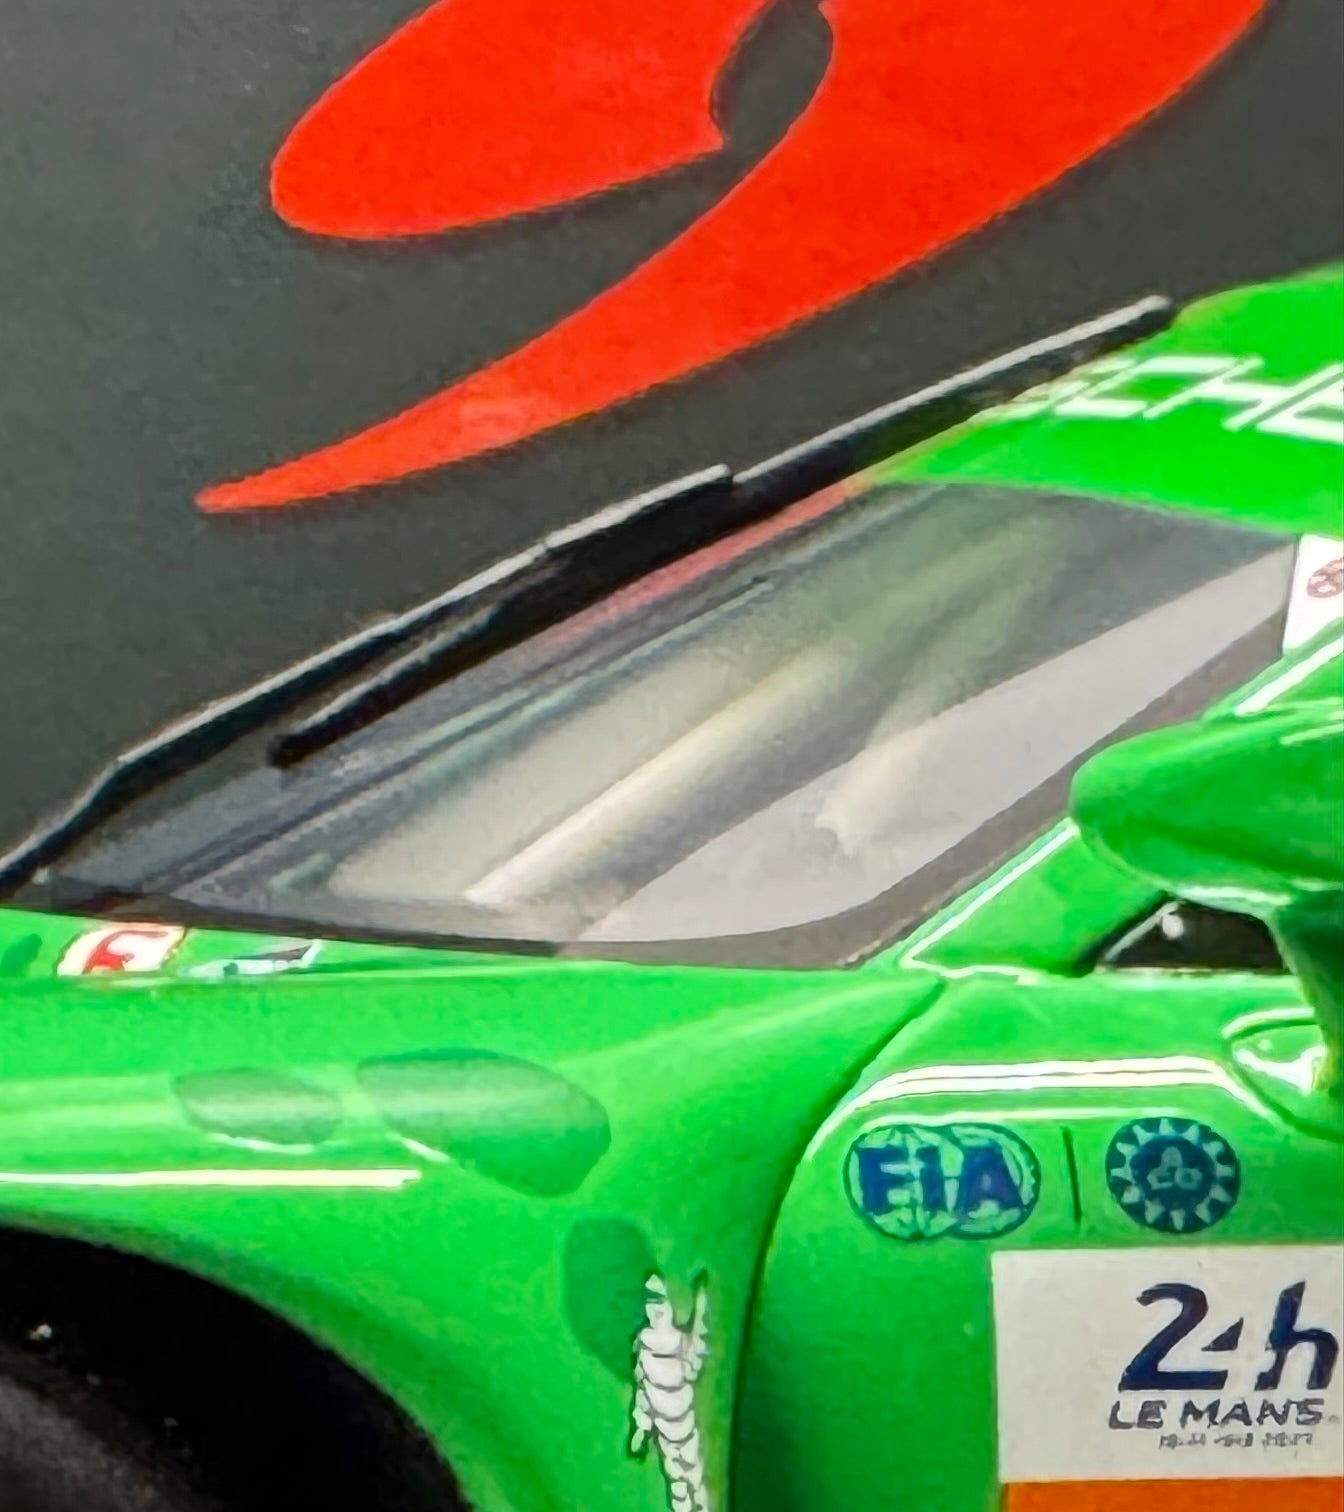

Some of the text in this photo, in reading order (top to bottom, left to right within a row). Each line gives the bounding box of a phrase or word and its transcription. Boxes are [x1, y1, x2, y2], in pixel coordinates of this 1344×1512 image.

[859, 1146, 1024, 1216] FIA
[1109, 1398, 1324, 1429] LE MANS
